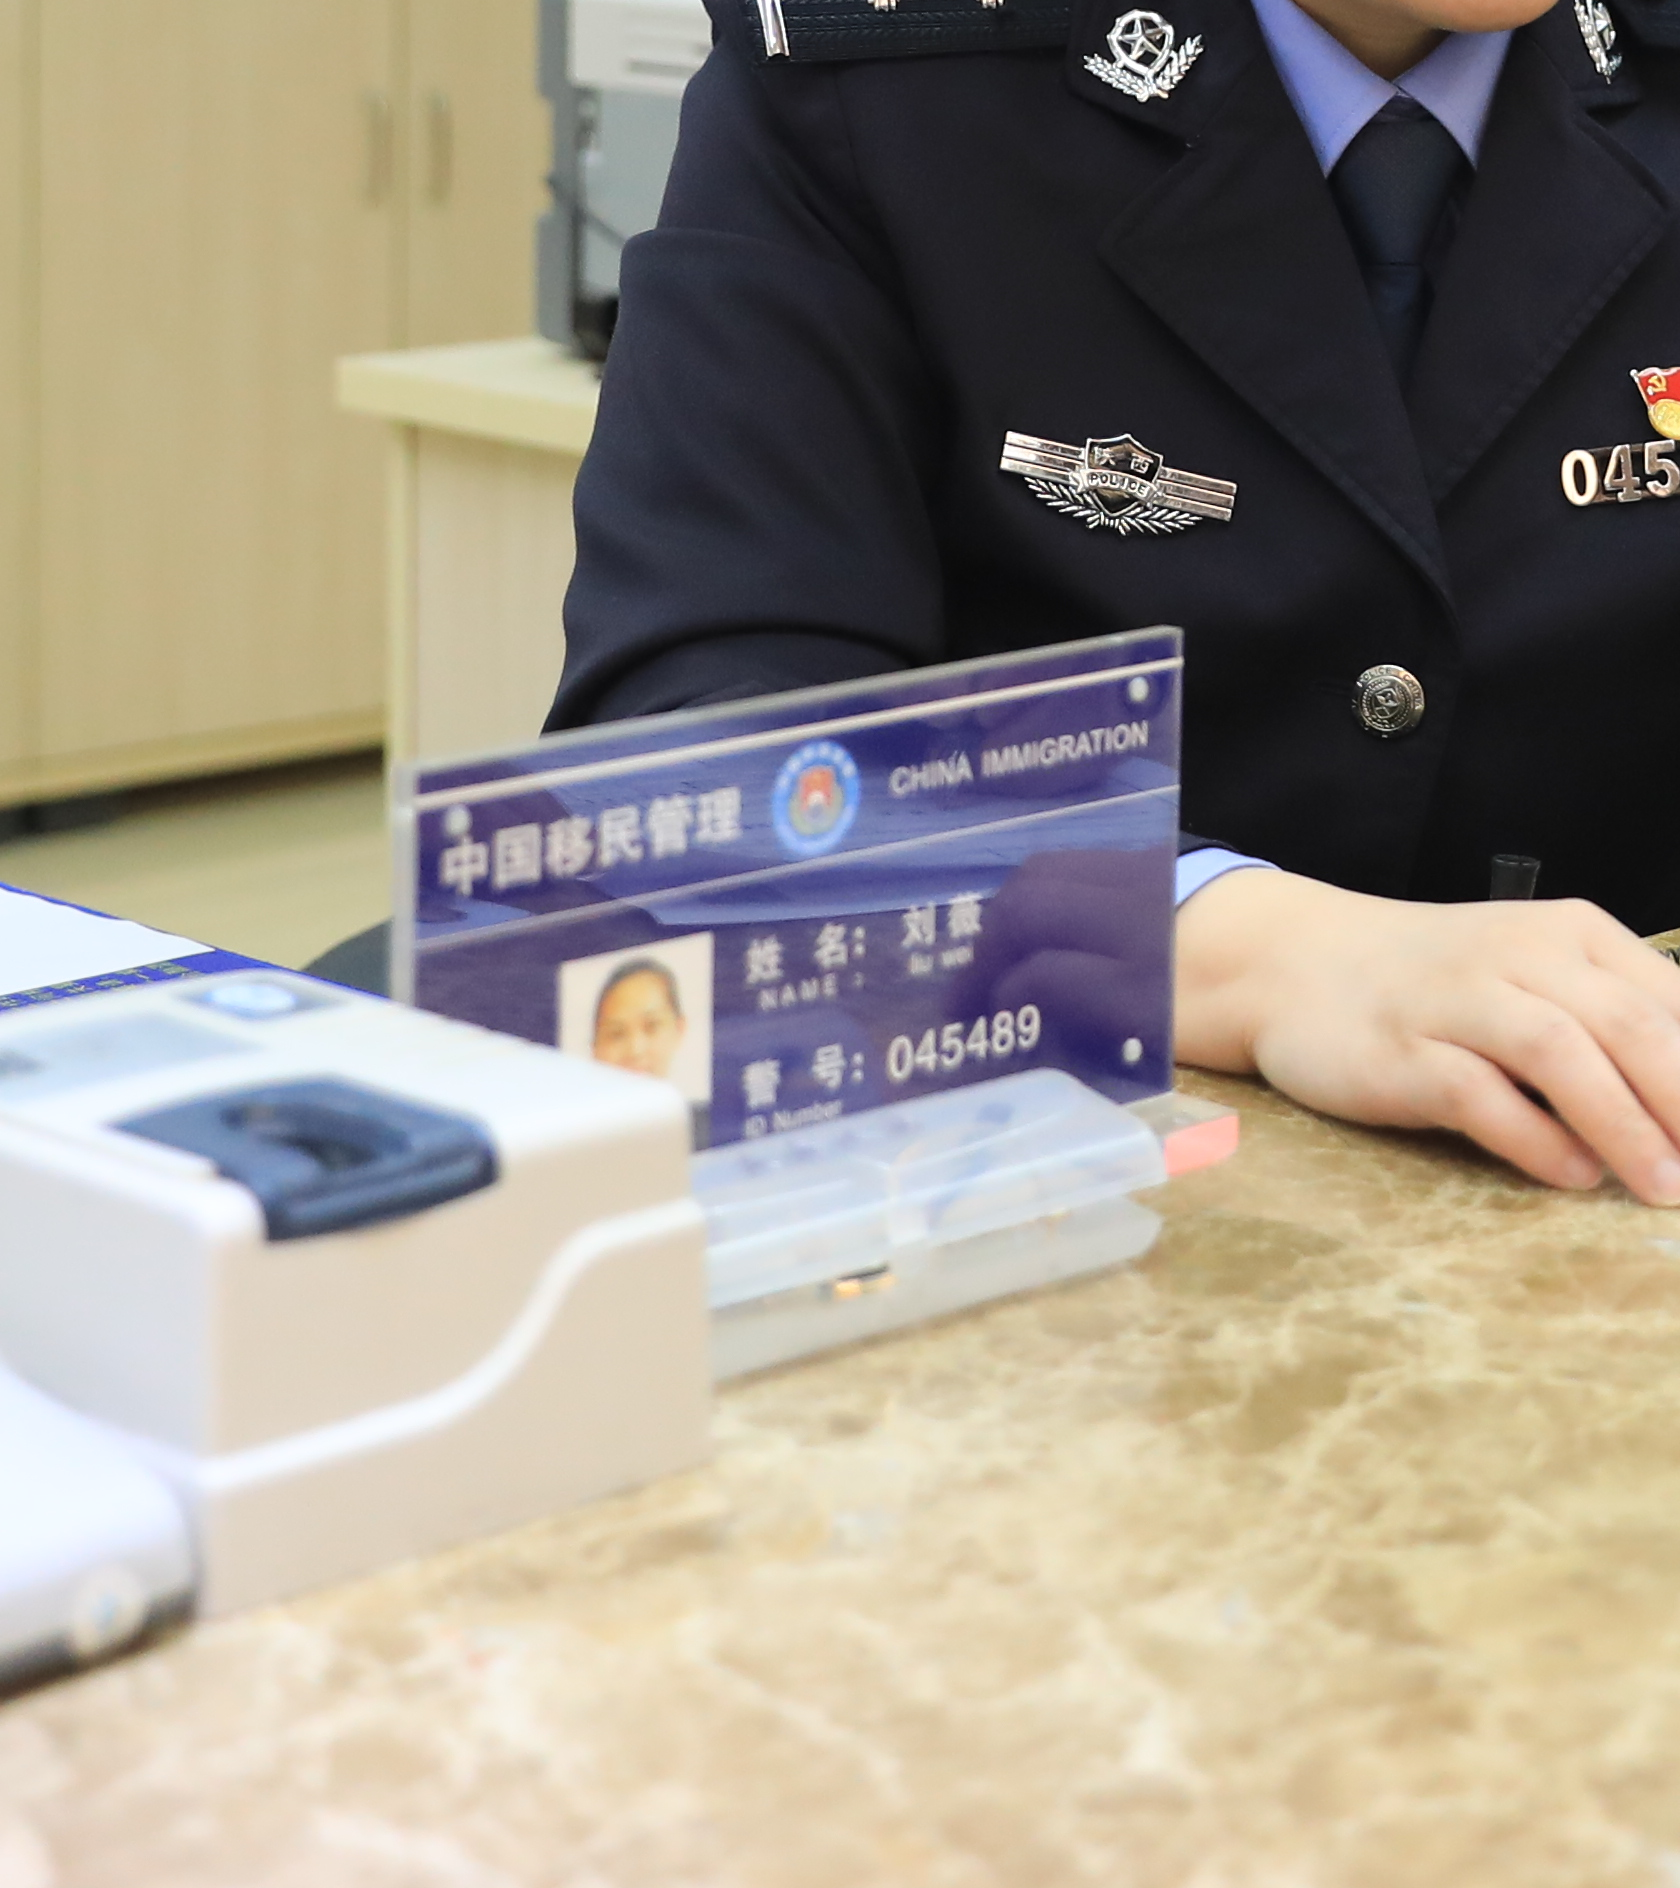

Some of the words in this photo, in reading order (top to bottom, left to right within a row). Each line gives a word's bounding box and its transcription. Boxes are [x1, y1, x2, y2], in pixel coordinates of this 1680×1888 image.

[1089, 473, 1147, 497] POLICE
[889, 752, 974, 797] CHINA
[981, 720, 1149, 777] IMMIGRATION
[439, 786, 742, 897] 中国移民管理
[886, 1004, 1041, 1083] 045489
